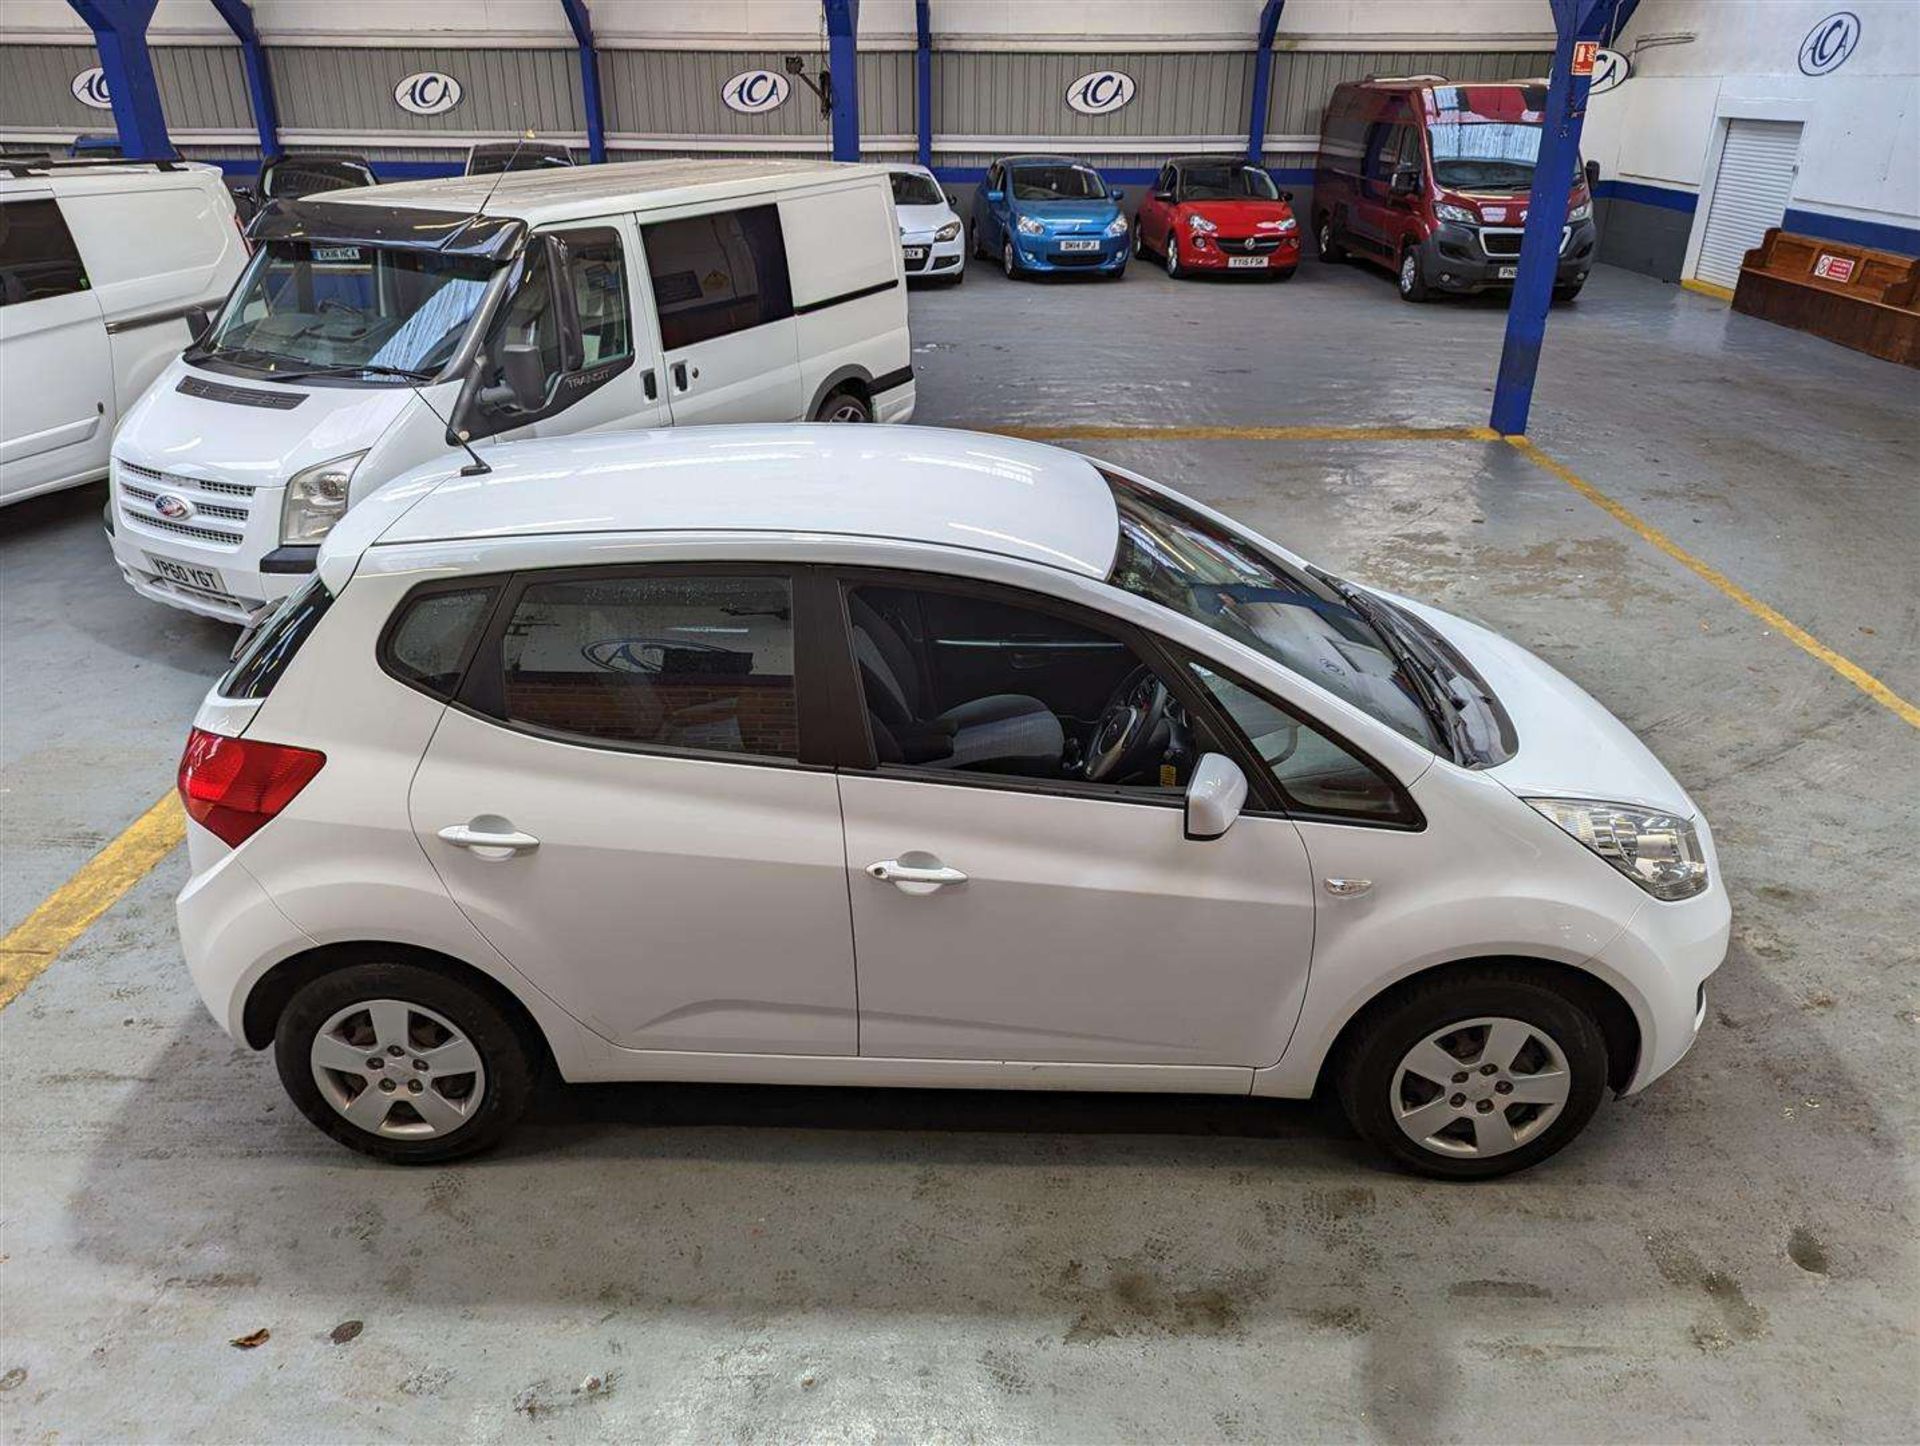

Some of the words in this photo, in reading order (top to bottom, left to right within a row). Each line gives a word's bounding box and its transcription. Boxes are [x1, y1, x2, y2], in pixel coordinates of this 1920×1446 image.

[1801, 19, 1850, 67] ACA
[76, 73, 111, 103] AC
[399, 76, 454, 108] ACA
[726, 74, 781, 107] ACA
[1069, 74, 1125, 107] ACA
[152, 557, 189, 582] YP60
[187, 567, 217, 590] YGT
